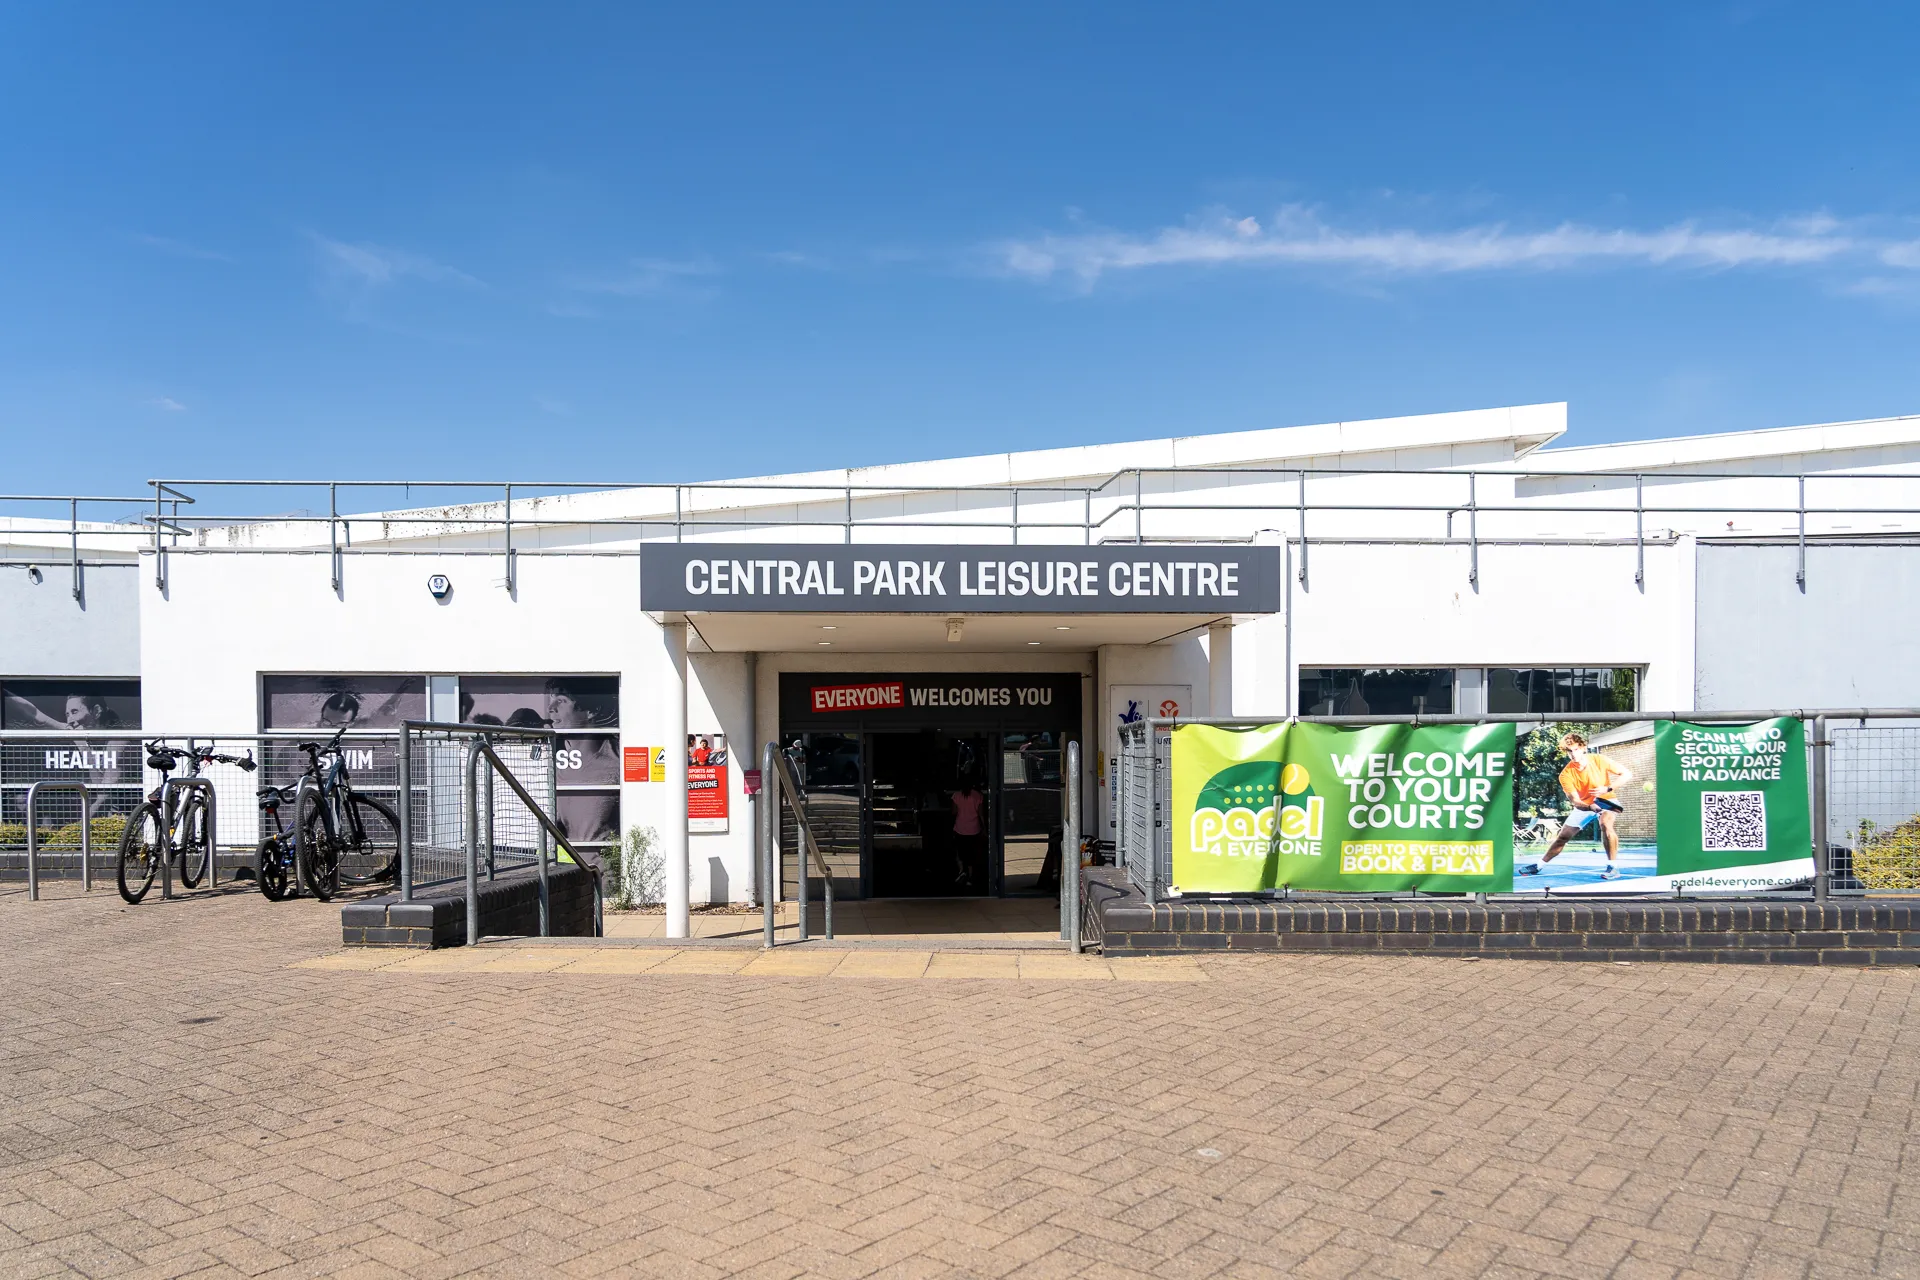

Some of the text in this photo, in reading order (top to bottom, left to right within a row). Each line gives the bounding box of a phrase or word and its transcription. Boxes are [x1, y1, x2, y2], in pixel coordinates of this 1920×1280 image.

[685, 559, 1240, 597] CENTRAL PARK LEISURE CENTRE
[815, 685, 1052, 709] EVERYONE WELCOMES YOU
[1682, 729, 1727, 743] SCAN
[1728, 732, 1755, 744] ME
[1675, 741, 1787, 755] SECURE YOUR
[45, 750, 117, 770] HEALTH
[1330, 752, 1506, 778] WELCOME
[1680, 754, 1782, 768] SPOT 7 DAYS
[1682, 768, 1781, 781] IN ADVANCE
[687, 780, 718, 789] EVERYONE
[1344, 778, 1492, 803] TO YOUR
[1191, 795, 1324, 852] padel
[1347, 803, 1486, 829] COURTS
[1209, 842, 1222, 857] 4
[1344, 844, 1490, 857] OPEN TO EVERYONE
[1342, 856, 1492, 873] BOOK & PLAY
